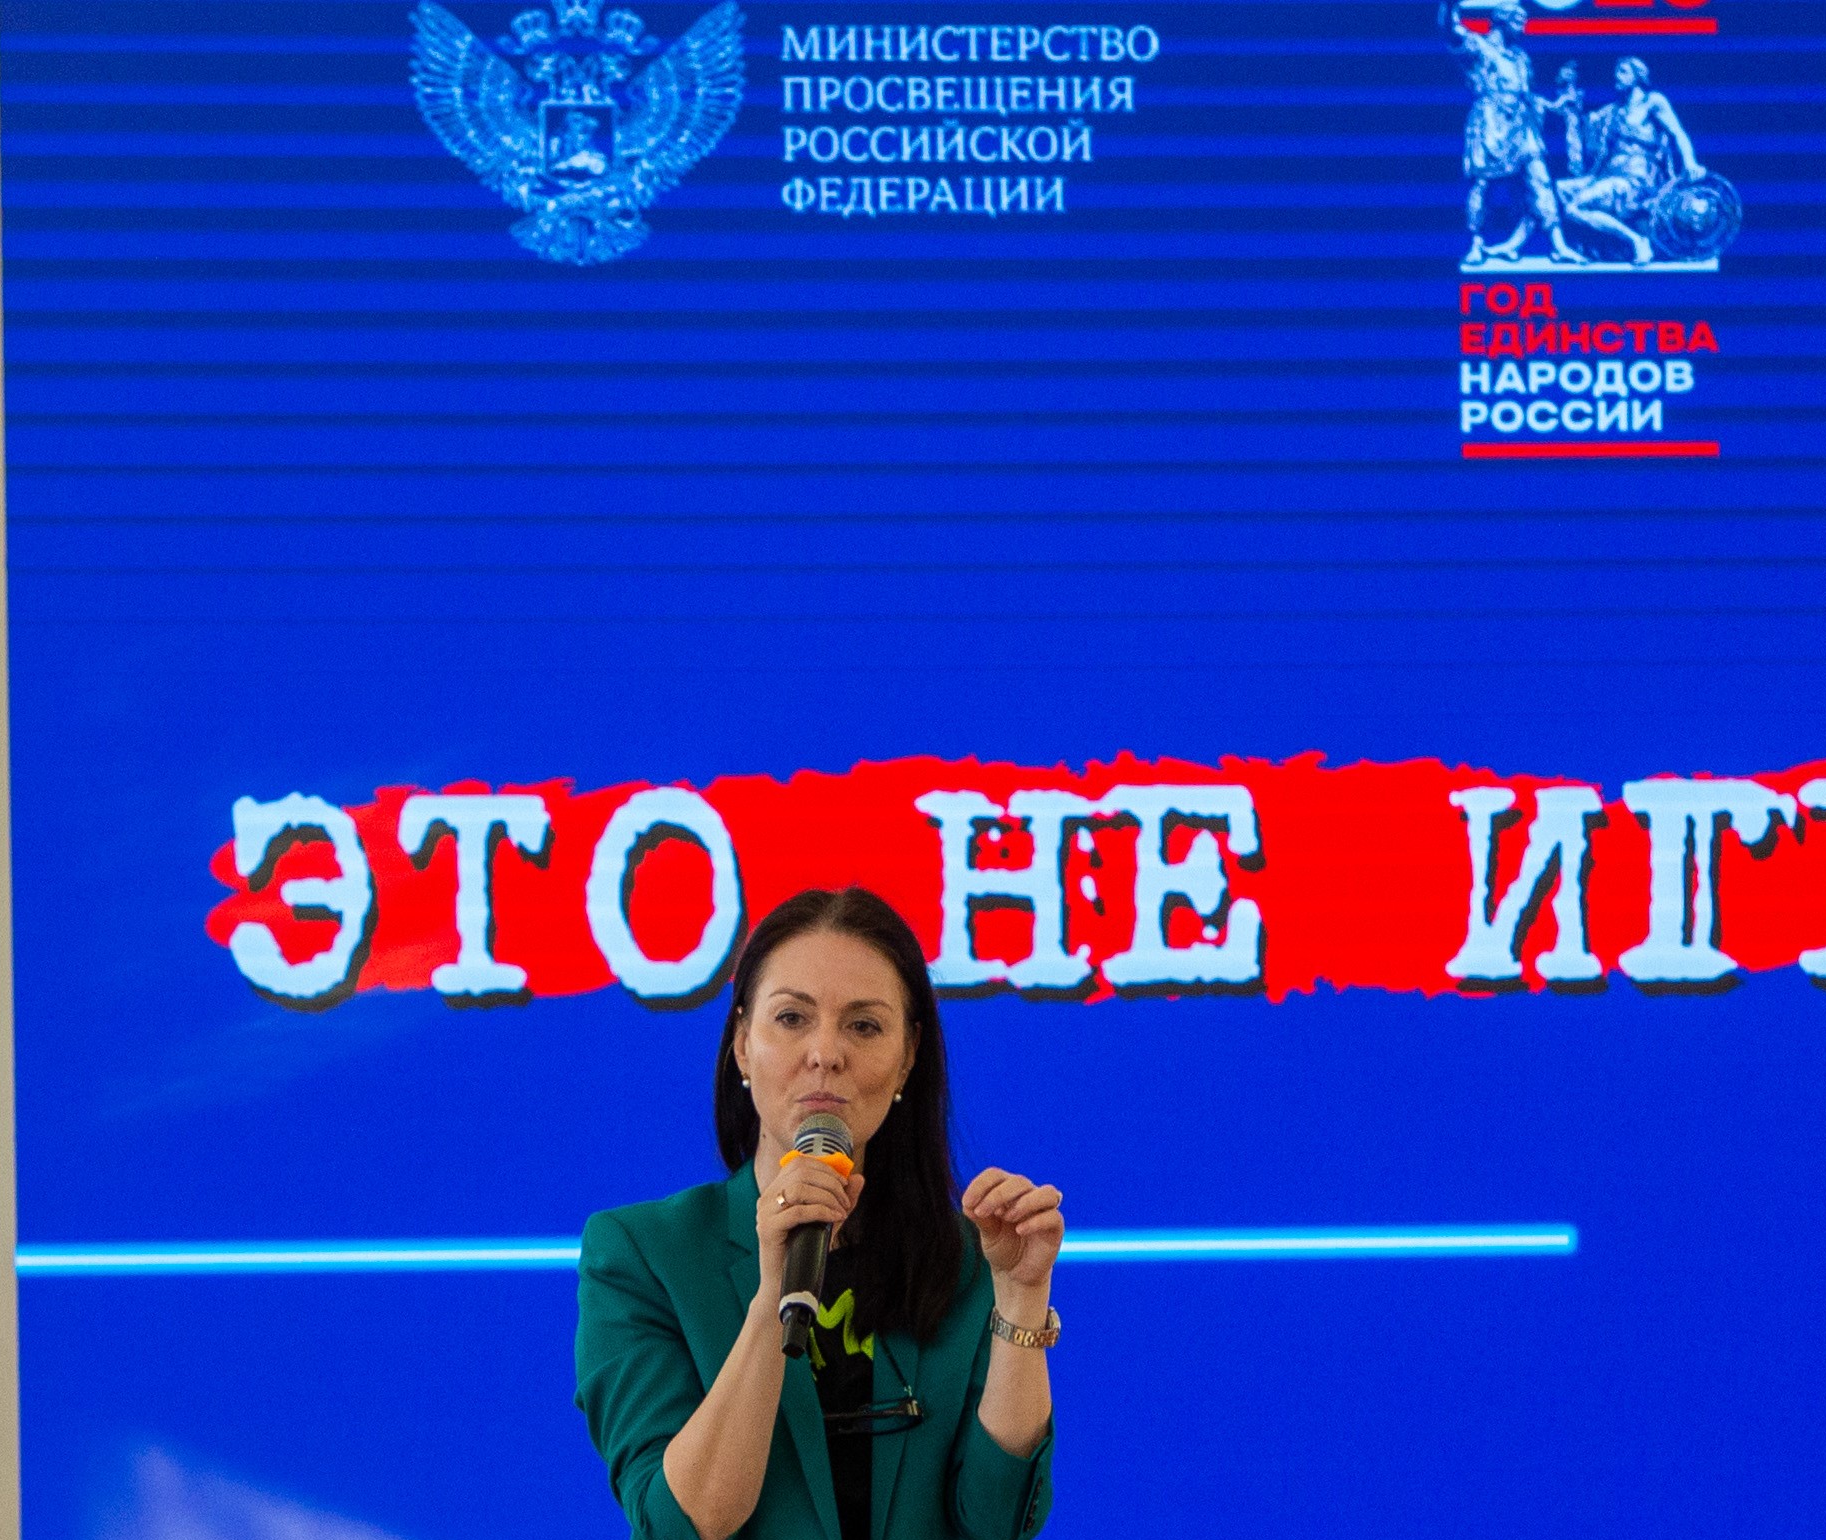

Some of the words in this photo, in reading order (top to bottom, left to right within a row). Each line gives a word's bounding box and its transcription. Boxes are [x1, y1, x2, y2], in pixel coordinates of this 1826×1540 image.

[780, 24, 1161, 63] МИНИСТЕРСТВО
[782, 75, 1135, 117] ПРОСВЕЩЕНИЯ
[782, 119, 1093, 163] РОССИЙСКОЙ
[780, 175, 1066, 218] ФЕДЕРАЦИИ
[1460, 282, 1557, 318] ГОД
[1460, 320, 1719, 359] ЕДИНСТВА
[1460, 360, 1695, 398] НАРОДОВ
[1460, 398, 1664, 434] РОССИИ
[228, 786, 748, 1005] ЭТО
[914, 783, 1268, 998] НЕ
